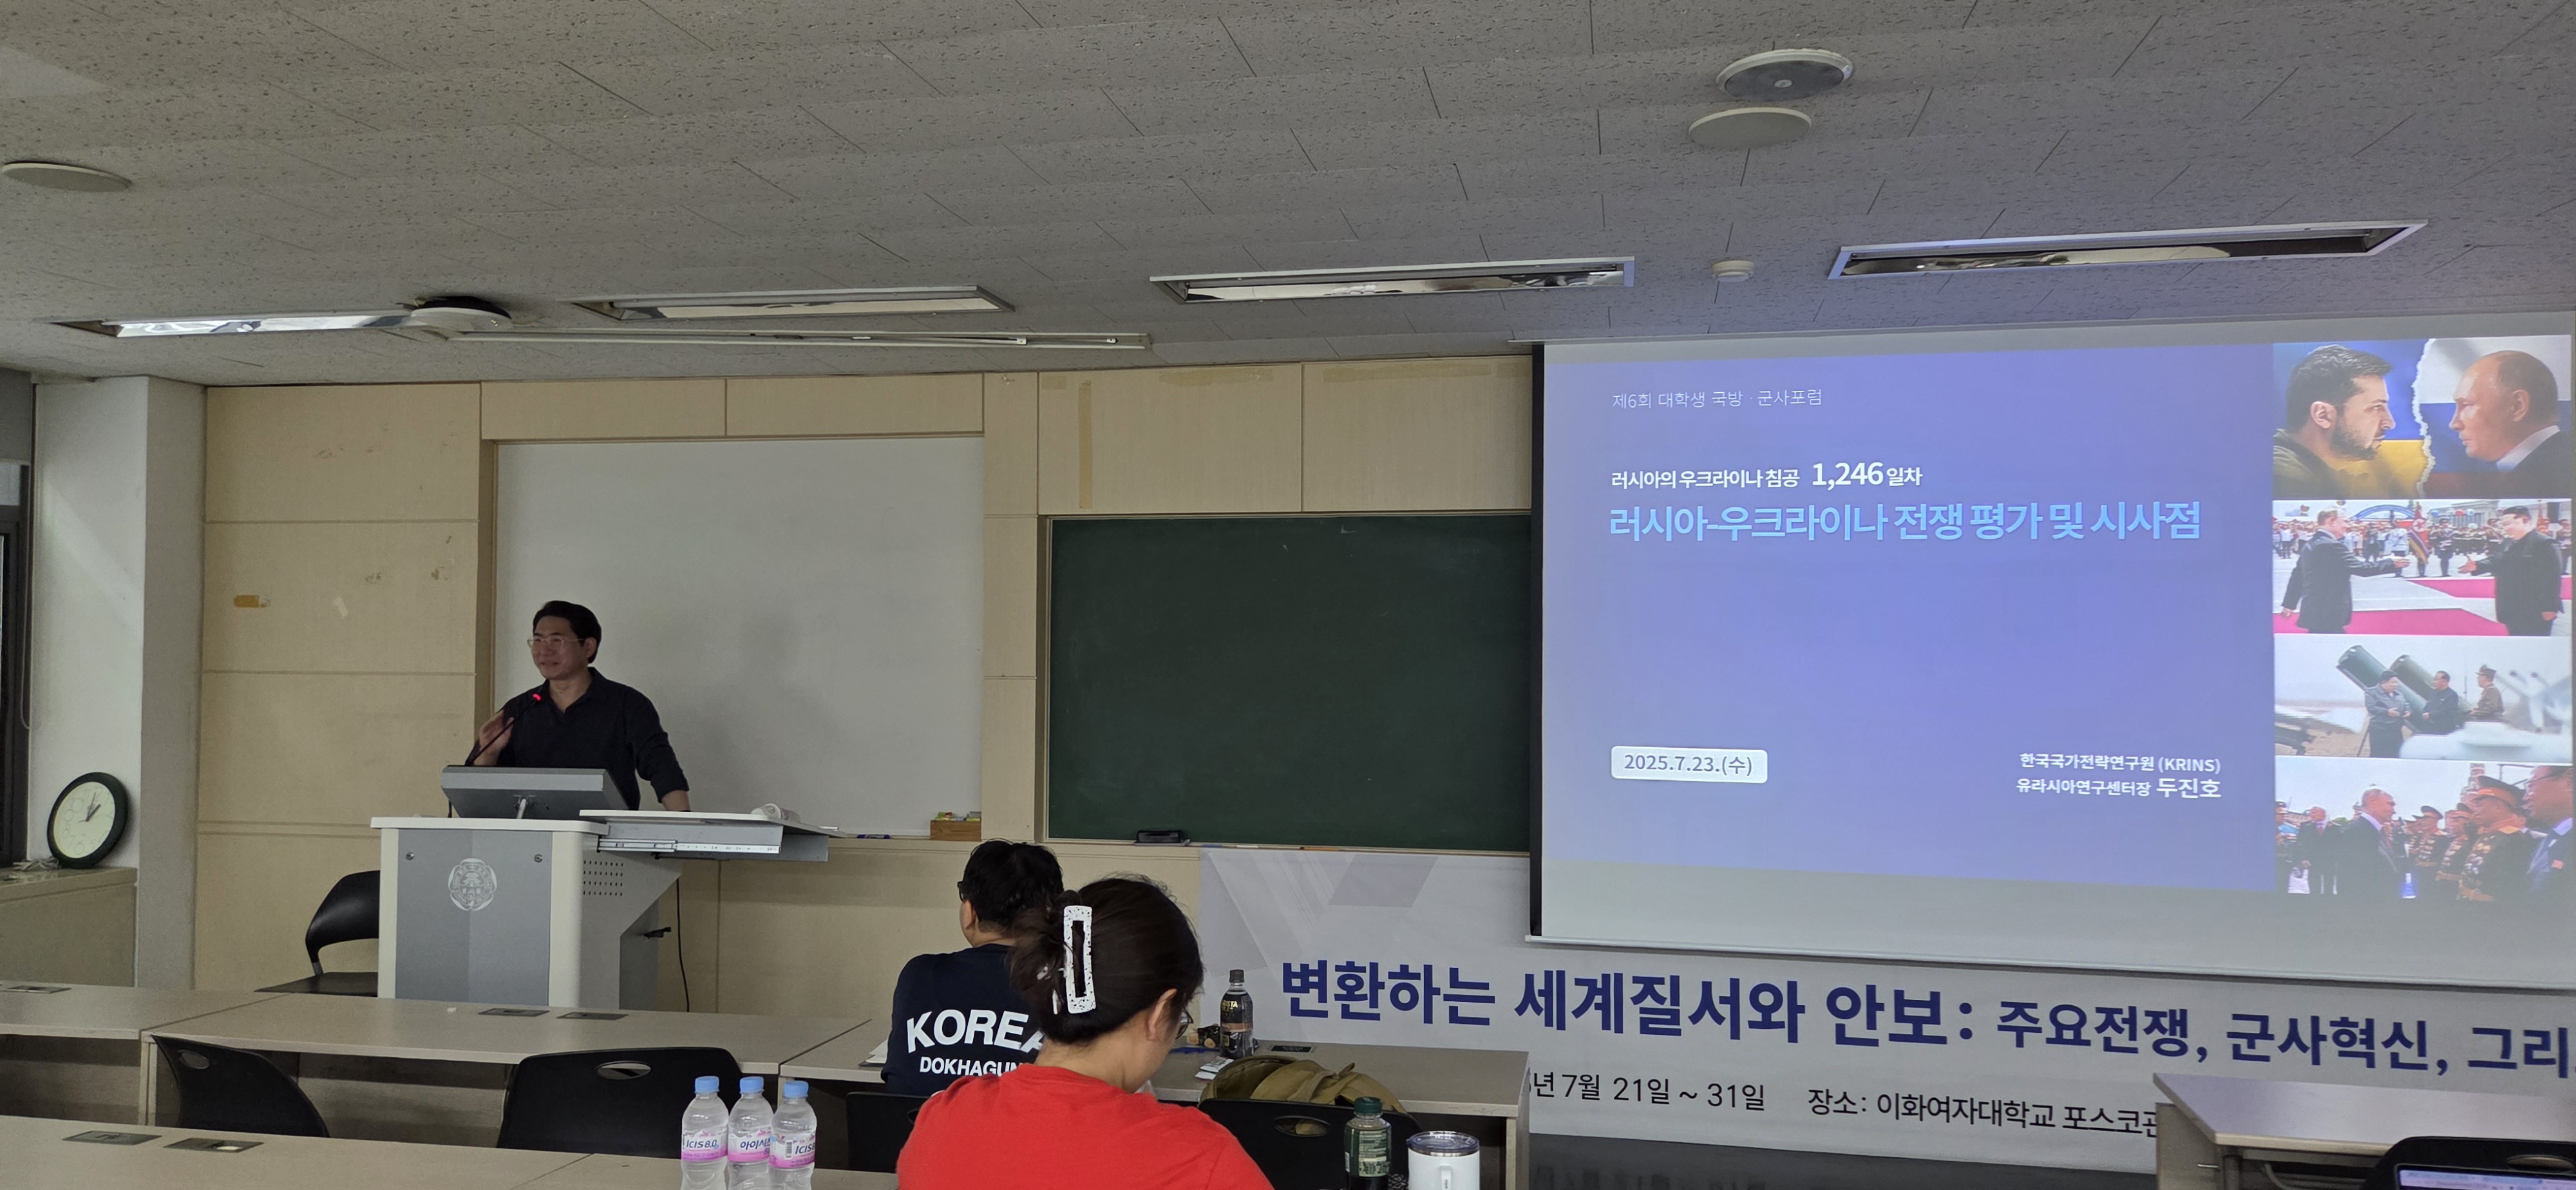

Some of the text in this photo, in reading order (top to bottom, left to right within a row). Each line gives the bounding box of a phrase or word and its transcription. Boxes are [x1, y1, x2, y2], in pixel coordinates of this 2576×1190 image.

[1612, 393, 1652, 409] 제6회
[1658, 392, 1705, 408] 대학생
[1711, 390, 1743, 407] 국방
[1757, 388, 1822, 406] 군사포럼
[1611, 470, 1676, 489] 러시아의
[1679, 469, 1763, 488] 우크라이나
[1765, 469, 1800, 488] 침공
[1610, 501, 2201, 542] 러시아-우크라이나 전쟁 평가 및 시사점
[1624, 754, 1752, 777] 2025.7.23.(수)
[2019, 753, 2221, 775] 한국국가전략연구원 (KRINS)
[2016, 777, 2222, 798] 유라시아연구센터장 두진호
[1282, 959, 2576, 1079] 변환하는 세계질서와 안보: 주요전쟁, 군사혁신, 그리
[1528, 1071, 1555, 1098] 년
[1562, 1074, 1600, 1100] 7월
[1613, 1077, 1671, 1105] 21일
[1707, 1083, 1765, 1111] 31일
[1808, 1089, 1867, 1115] 장소:
[1877, 1093, 2056, 1129] 이화여자대학교
